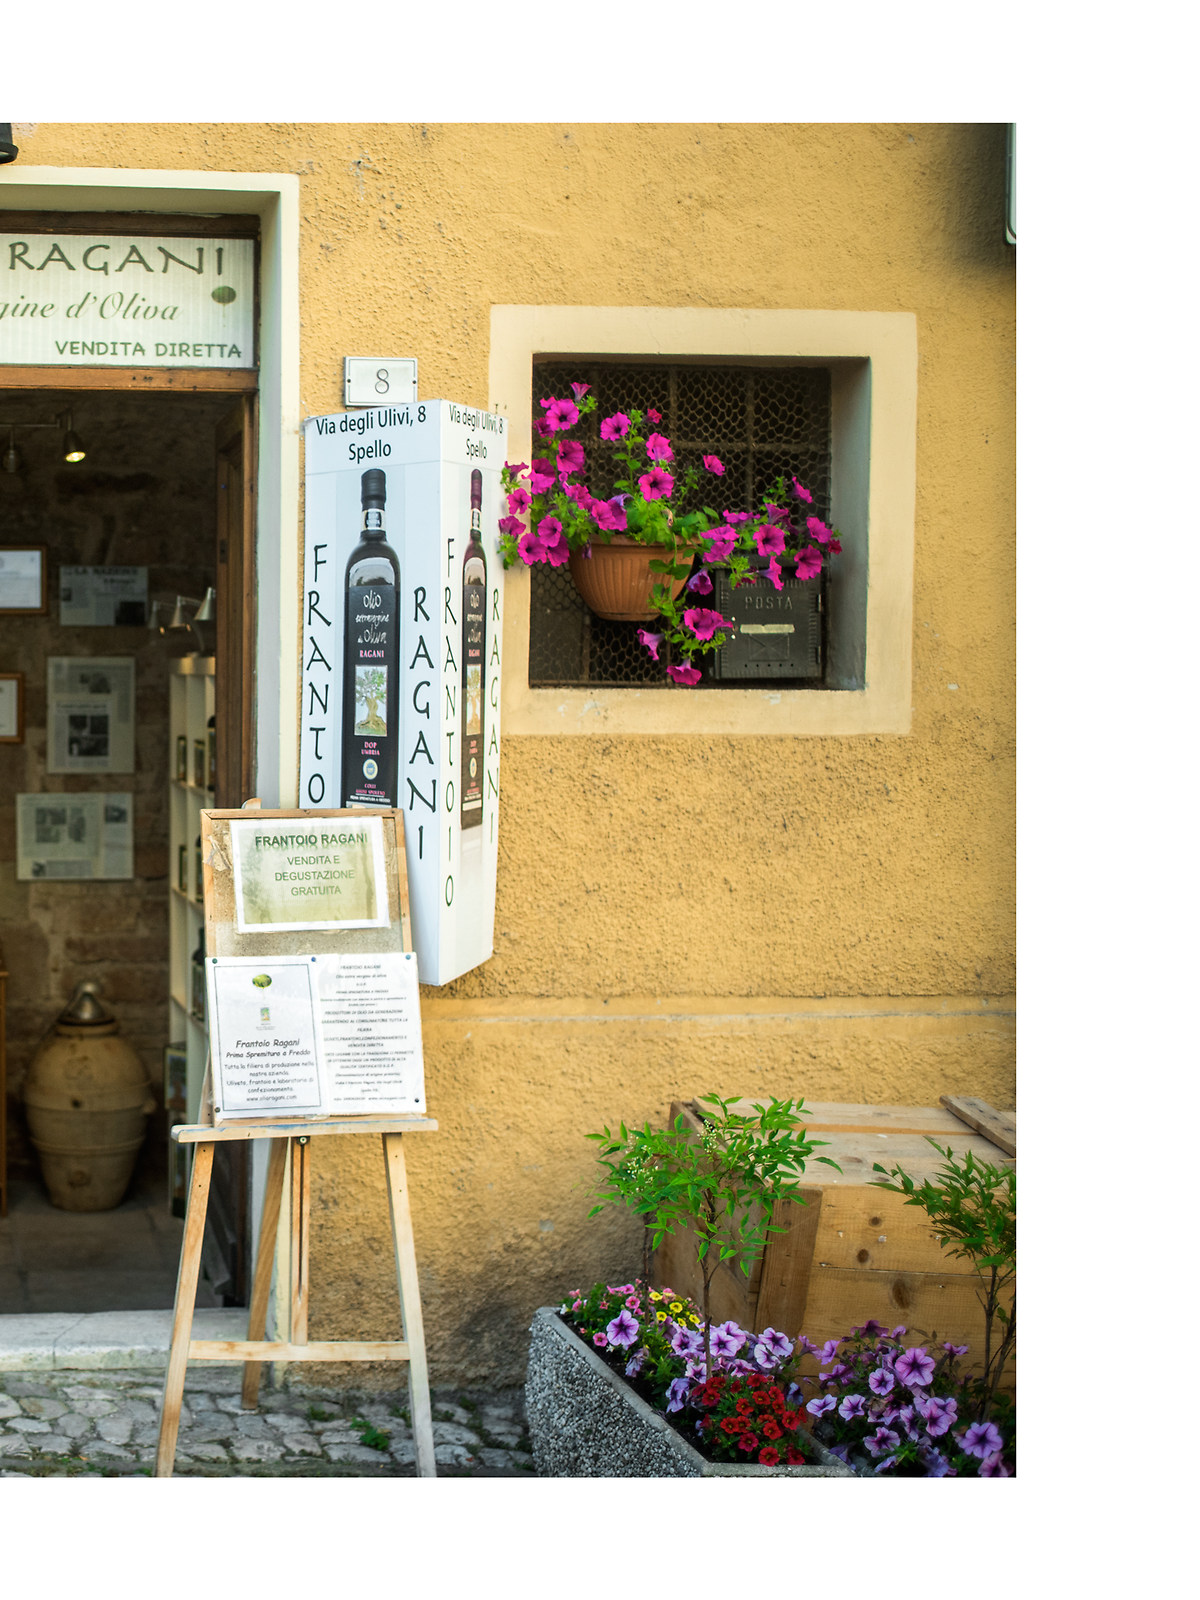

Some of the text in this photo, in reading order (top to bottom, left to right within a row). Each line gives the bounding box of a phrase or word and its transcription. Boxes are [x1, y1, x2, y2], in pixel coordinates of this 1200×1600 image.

[8, 241, 225, 275] RAGANI
[65, 289, 181, 321] d'Oliva
[54, 340, 242, 359] VENDITA DIRETTA
[374, 368, 390, 394] 8
[315, 405, 427, 436] Via degli Ulivi, 8
[448, 403, 460, 423] Via
[462, 406, 480, 432] degli
[498, 417, 504, 434] 8
[348, 439, 392, 464] Spello
[465, 438, 488, 461] Spello
[745, 596, 793, 610] POSTA
[360, 649, 385, 658] RAGANI
[306, 544, 332, 804] FRANTO
[407, 586, 437, 860] RAGANI
[364, 741, 378, 749] DOP
[255, 832, 368, 848] FRANTOIO RAGANI
[287, 855, 341, 866] VENDITA E
[274, 869, 355, 882] DEGUSTAZIONE
[290, 885, 342, 896] GRATUITA
[235, 1038, 300, 1049] Frantoio Ragani
[245, 1050, 280, 1059] Spremitura
